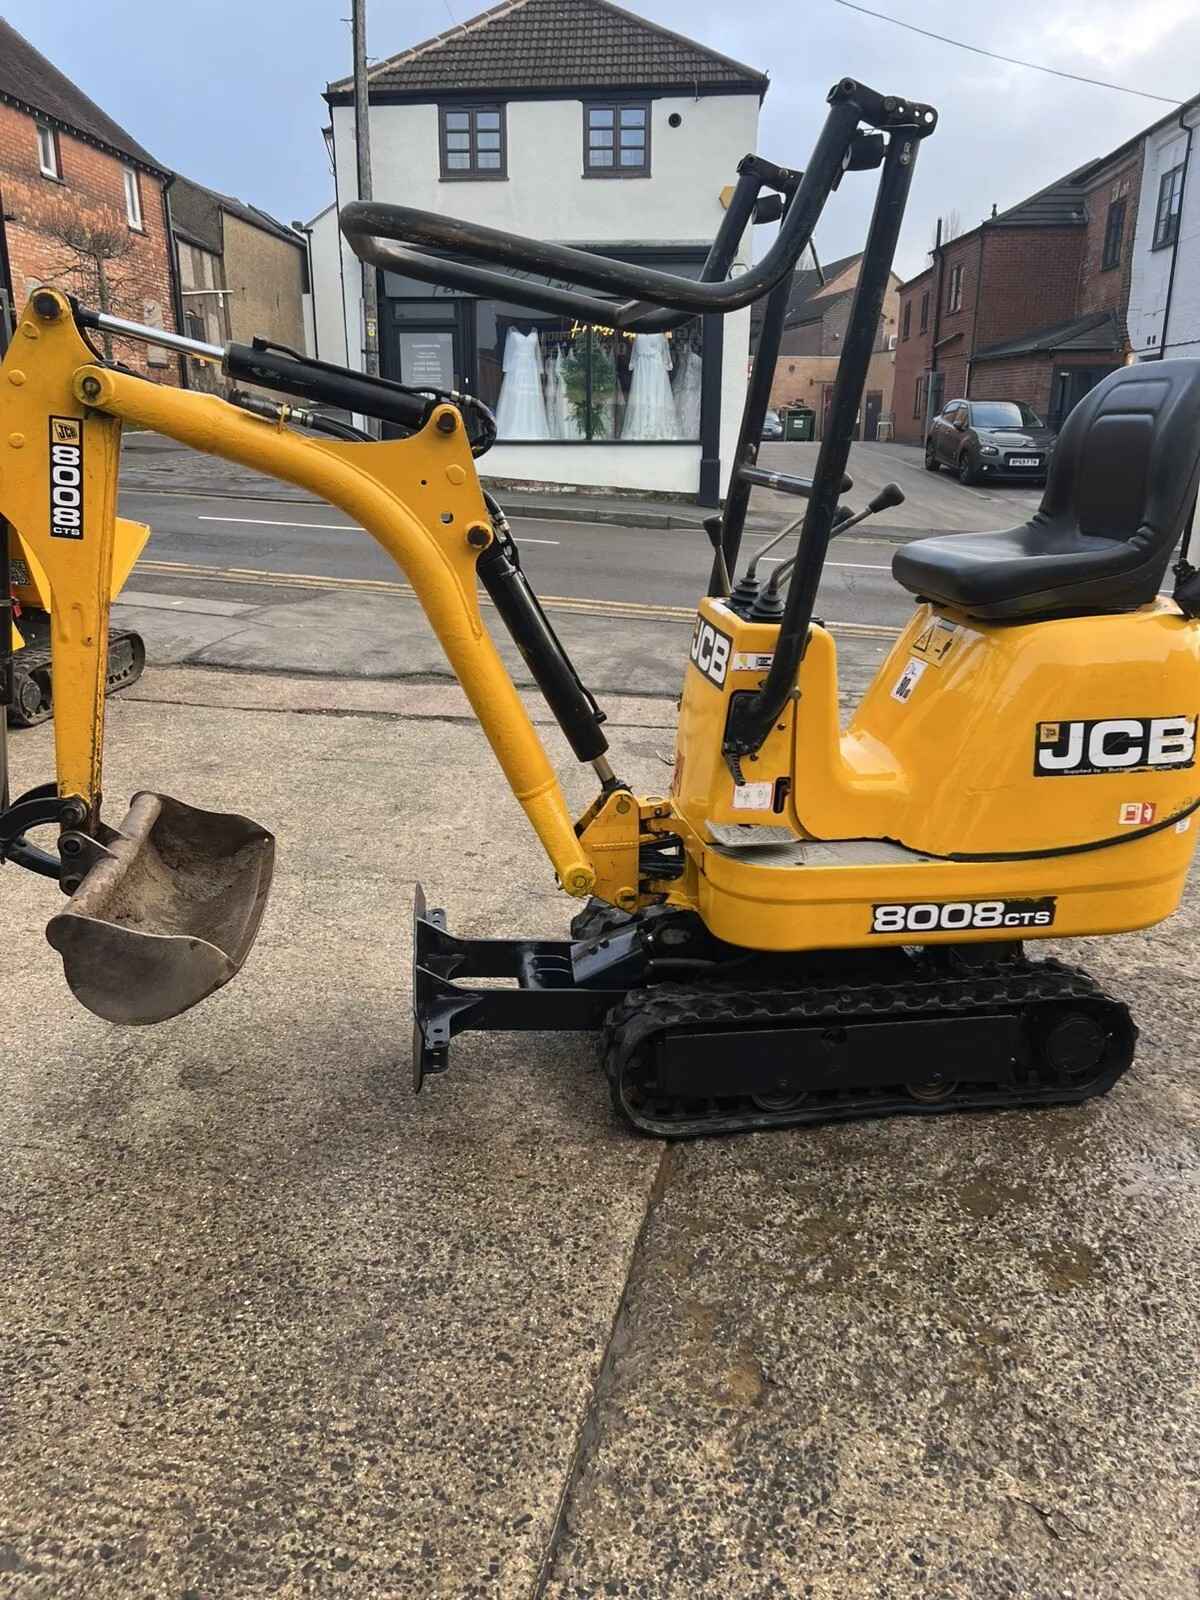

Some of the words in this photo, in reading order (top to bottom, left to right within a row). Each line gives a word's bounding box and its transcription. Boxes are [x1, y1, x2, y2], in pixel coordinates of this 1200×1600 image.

[52, 445, 81, 527] 8008
[53, 527, 80, 536] CTS
[691, 617, 731, 684] JCB
[1039, 718, 1196, 769] JCB
